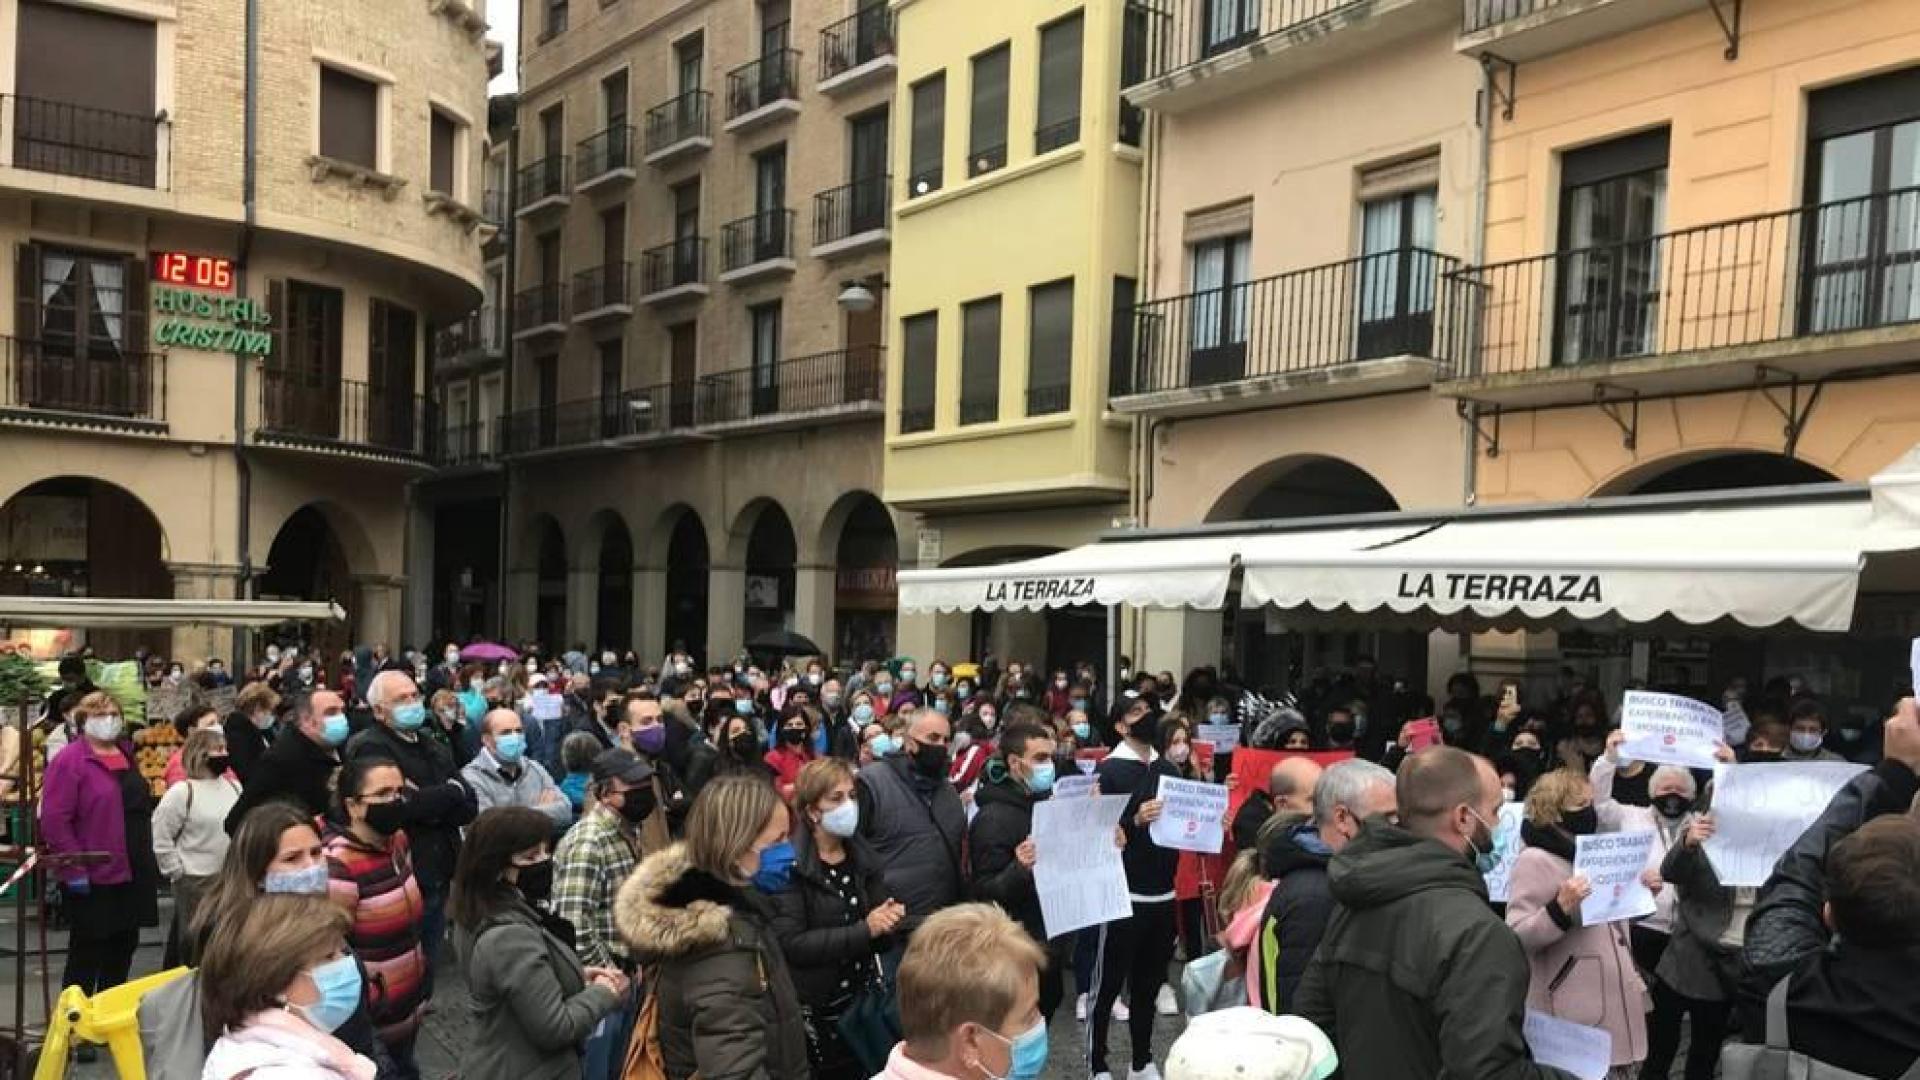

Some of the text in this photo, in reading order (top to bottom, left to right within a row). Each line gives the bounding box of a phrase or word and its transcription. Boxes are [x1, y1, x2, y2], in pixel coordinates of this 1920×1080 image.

[162, 253, 230, 288] 12 06
[154, 318, 272, 355] CRISTINA
[986, 578, 1095, 602] LA TERRAZA
[1397, 572, 1603, 603] LA TERRAZA
[1628, 695, 1666, 706] BUSCO
[1163, 780, 1196, 793] BUSCO
[1582, 839, 1614, 852] BUSCO
